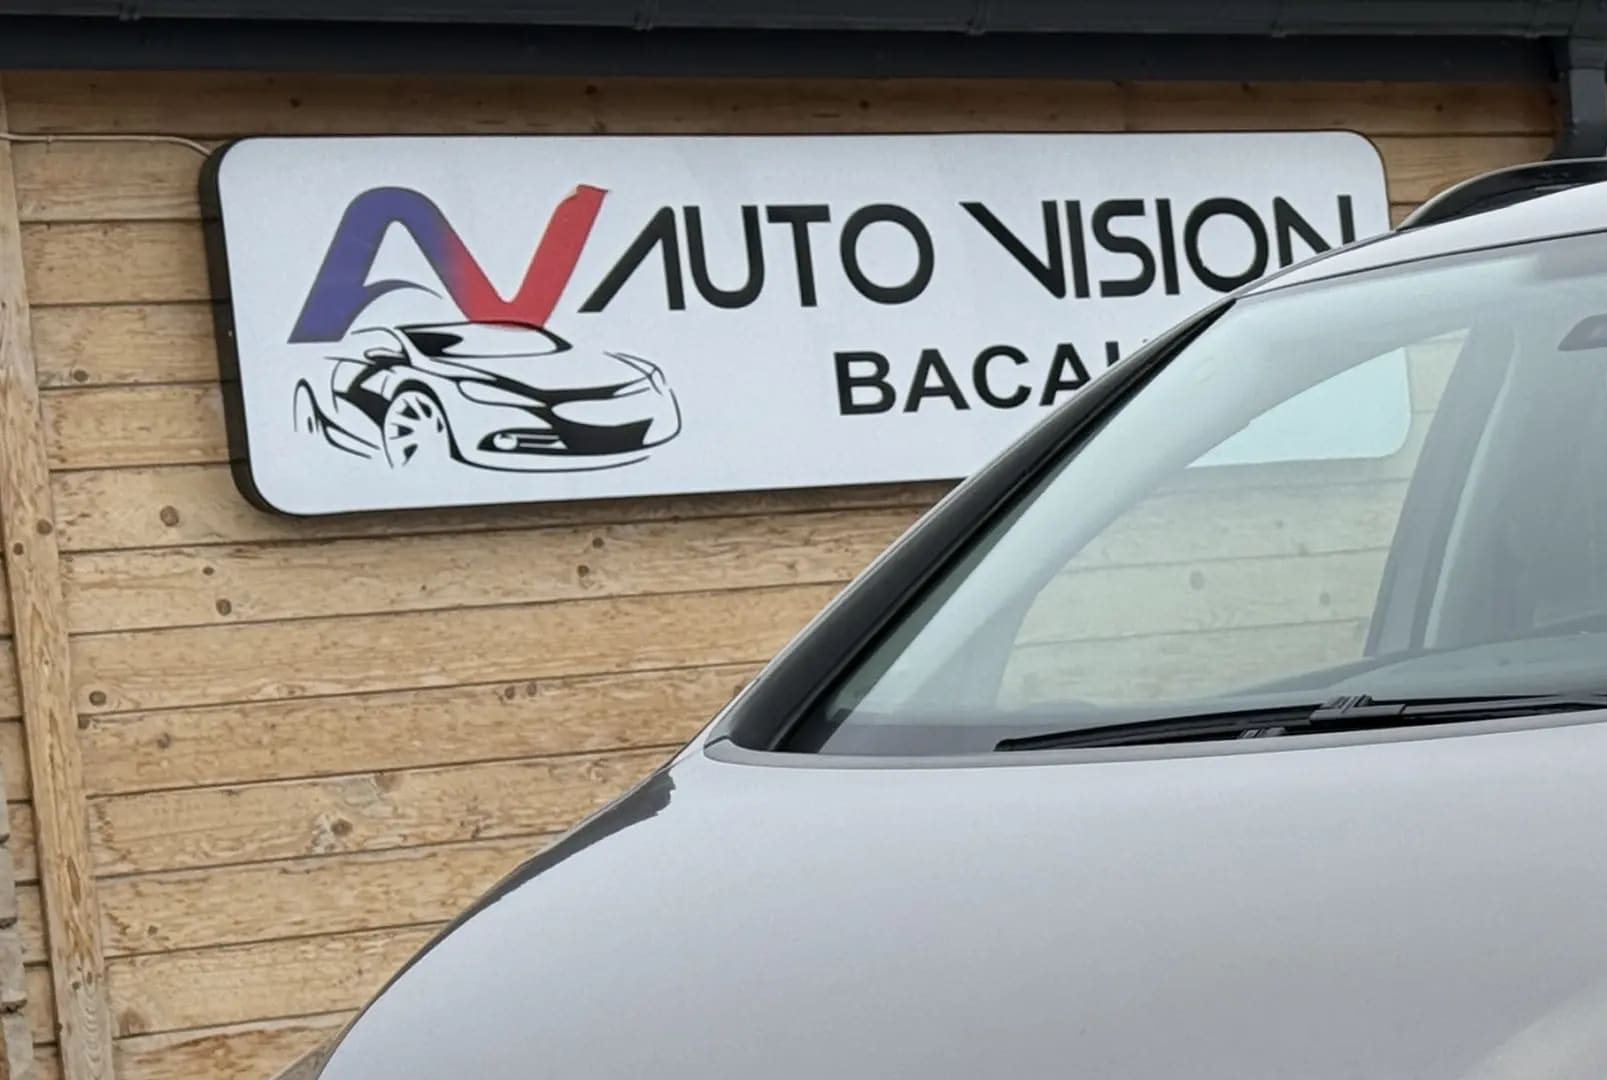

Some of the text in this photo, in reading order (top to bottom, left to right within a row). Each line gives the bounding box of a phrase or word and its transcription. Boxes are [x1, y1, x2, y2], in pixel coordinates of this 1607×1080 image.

[578, 193, 1356, 313] AUTO VISION
[833, 340, 1148, 416] BACA
